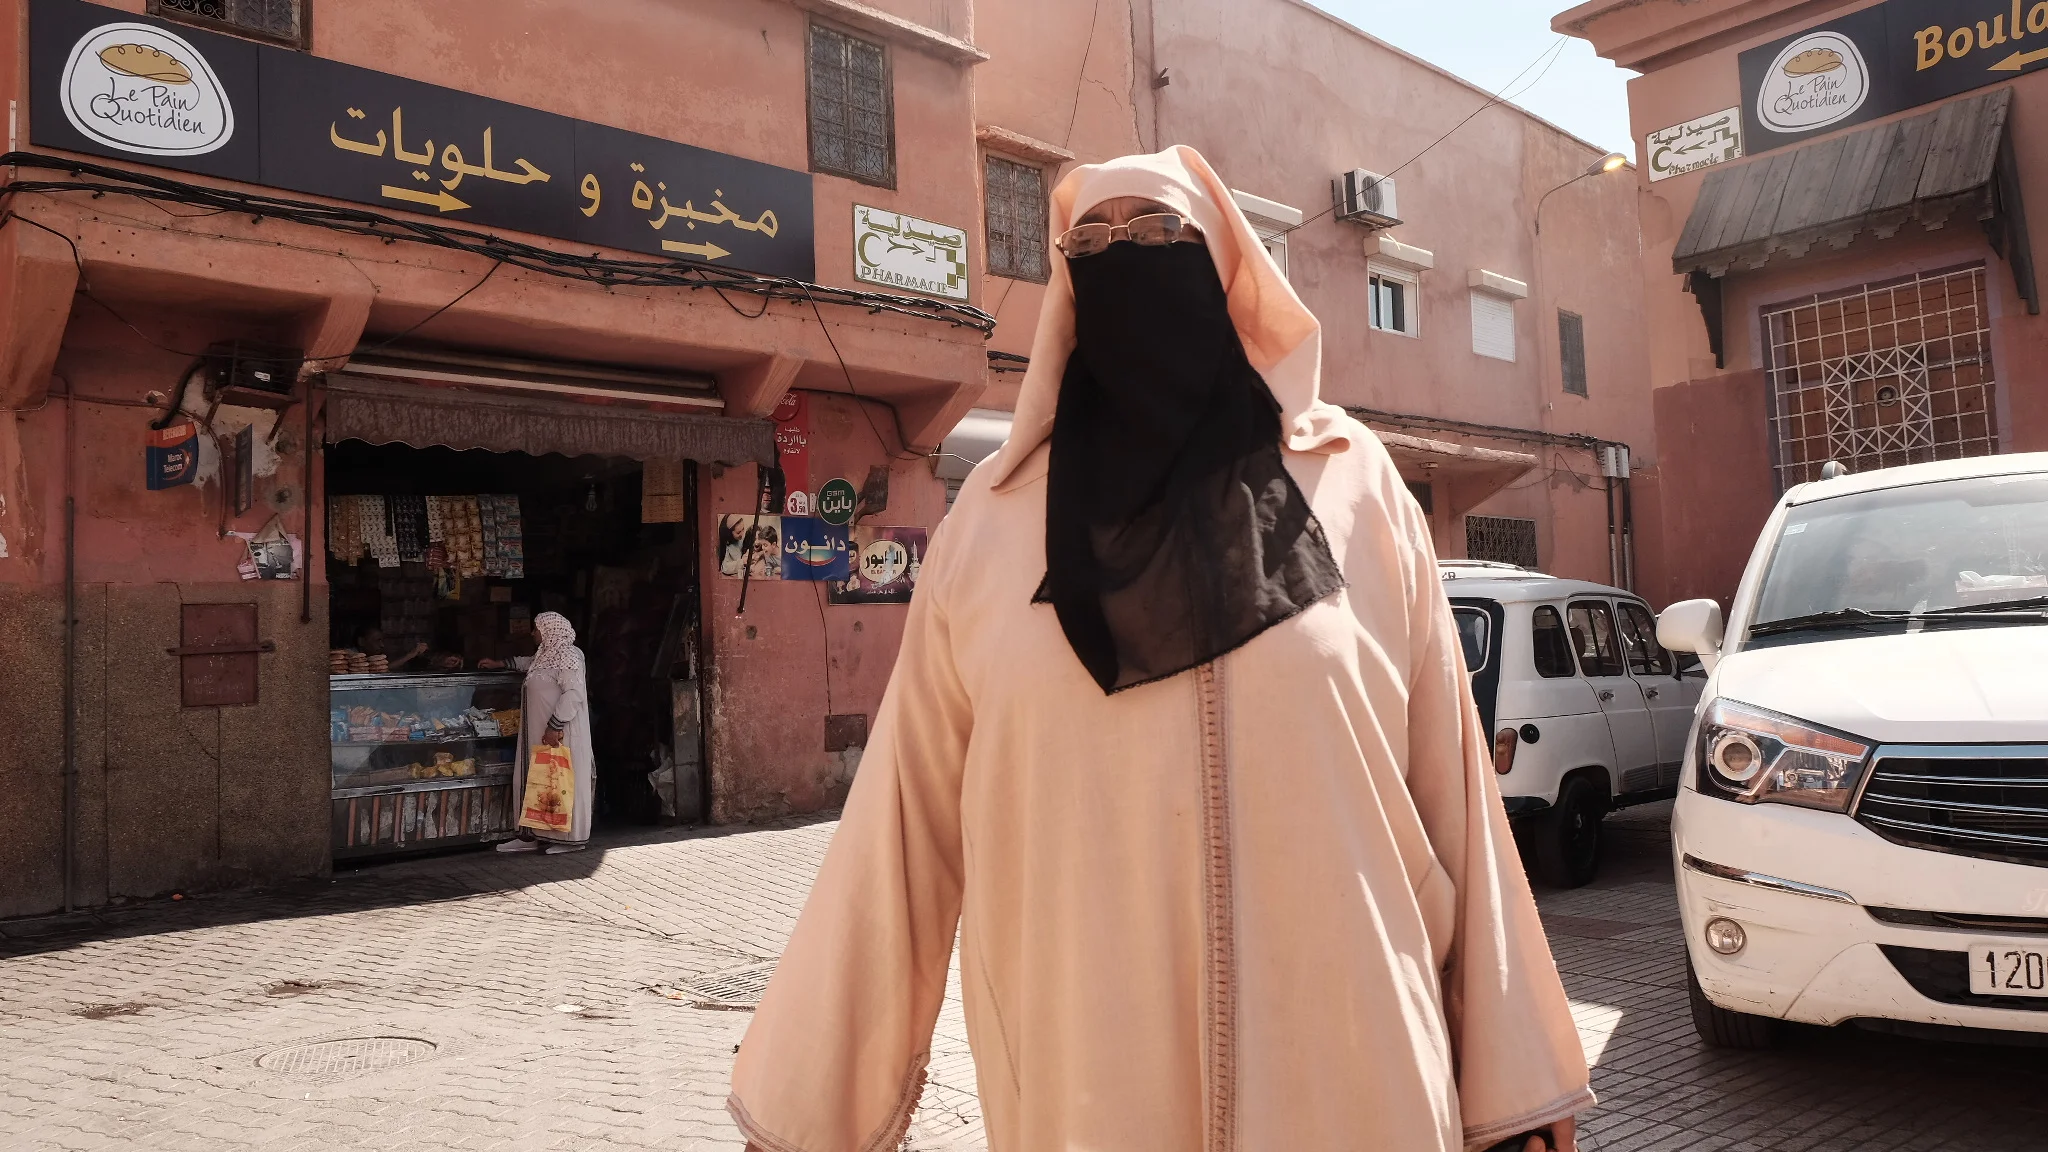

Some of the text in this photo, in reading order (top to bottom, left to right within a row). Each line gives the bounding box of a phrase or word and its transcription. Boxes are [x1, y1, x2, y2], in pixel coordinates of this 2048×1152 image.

[99, 77, 200, 112] Le Pain
[1774, 91, 1847, 115] Quotidien
[1780, 75, 1846, 101] Le Pain
[90, 93, 206, 134] Quotidien
[1651, 115, 1731, 146] صيدلية
[330, 105, 778, 239] مخبزة و حلويات
[858, 208, 963, 249] صيدلية
[860, 265, 948, 294] PHARMACIE
[784, 535, 847, 556] دانون
[1985, 950, 2048, 990] 120
